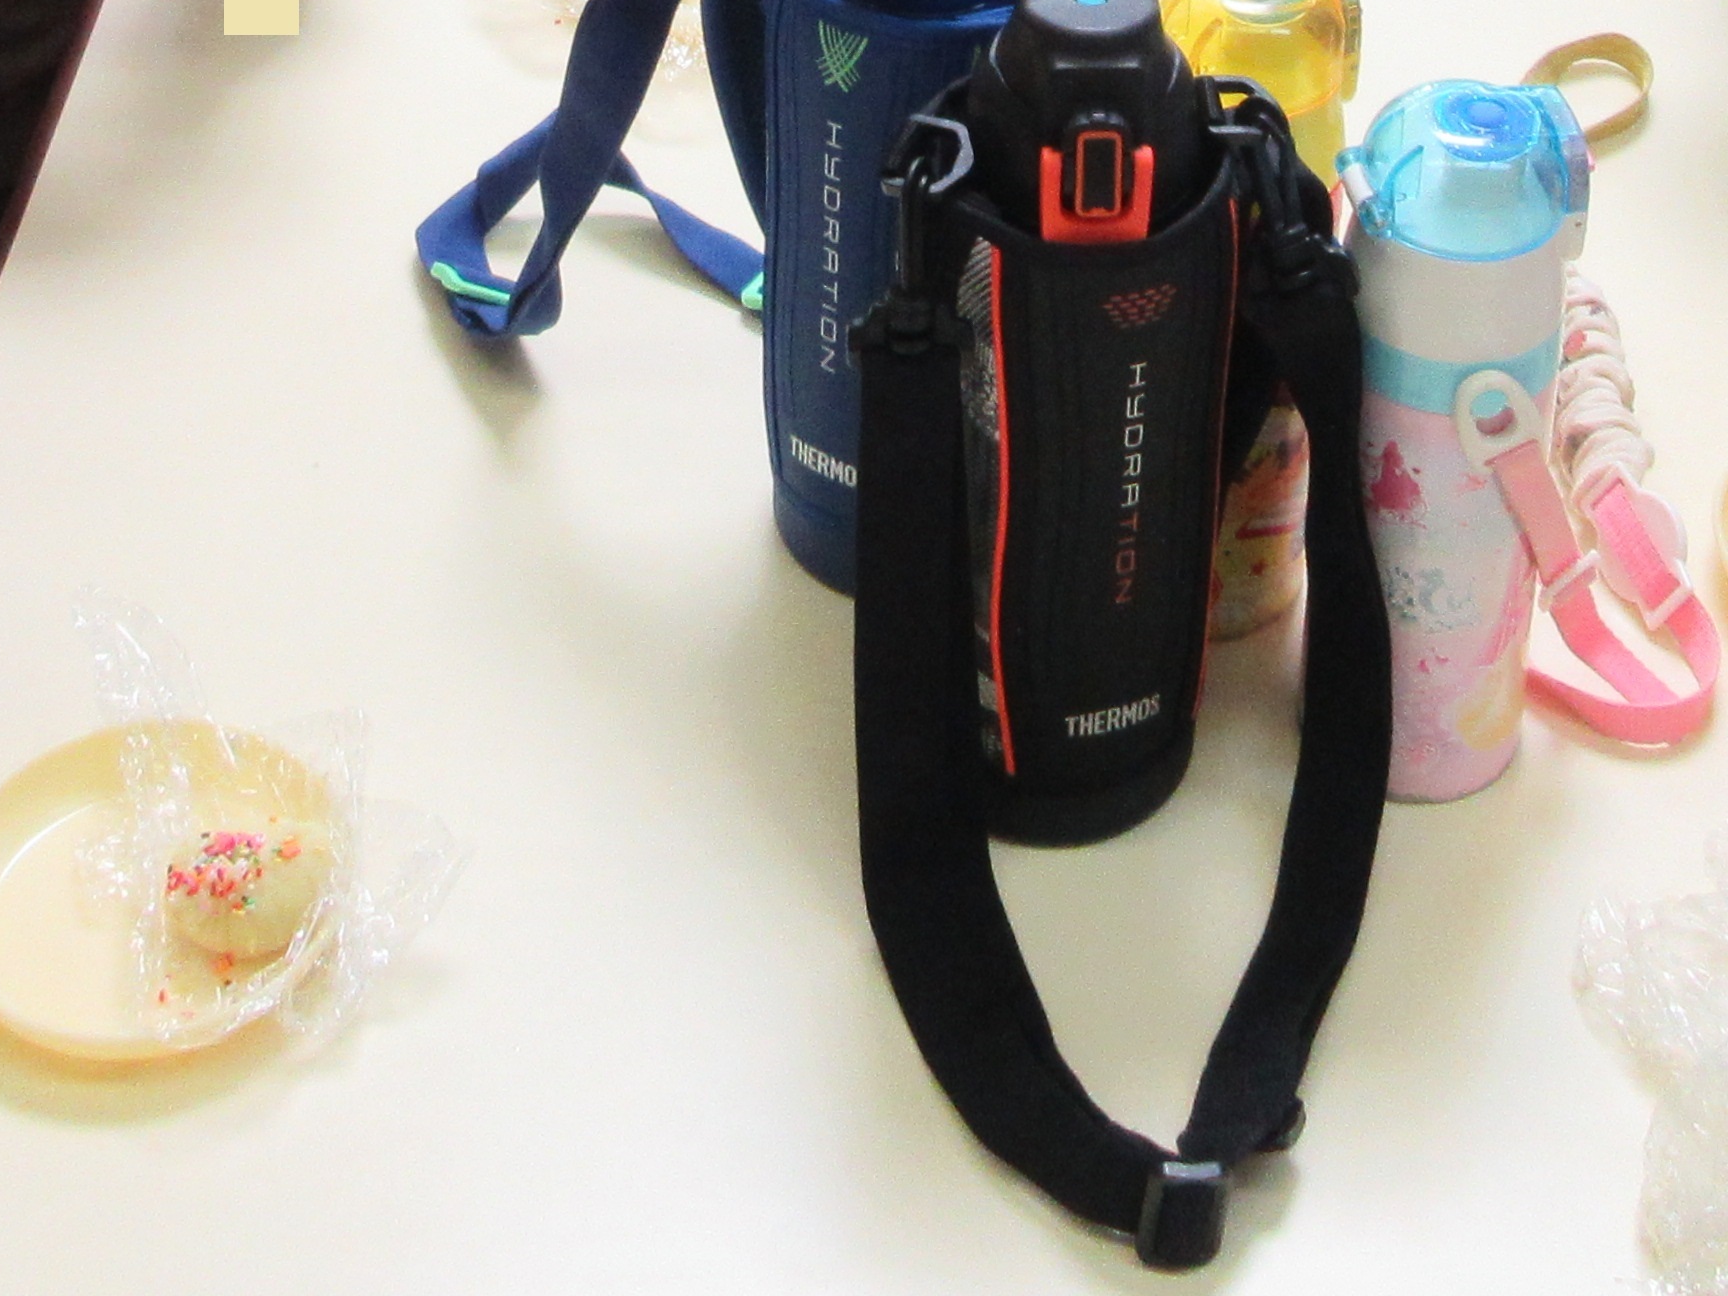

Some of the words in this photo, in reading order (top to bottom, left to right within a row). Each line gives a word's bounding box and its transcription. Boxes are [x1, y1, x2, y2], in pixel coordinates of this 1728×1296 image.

[818, 119, 844, 375] HYDRATION
[789, 433, 859, 489] THERMO
[1114, 360, 1148, 605] HYDRATION
[1064, 691, 1161, 738] THERMOS
